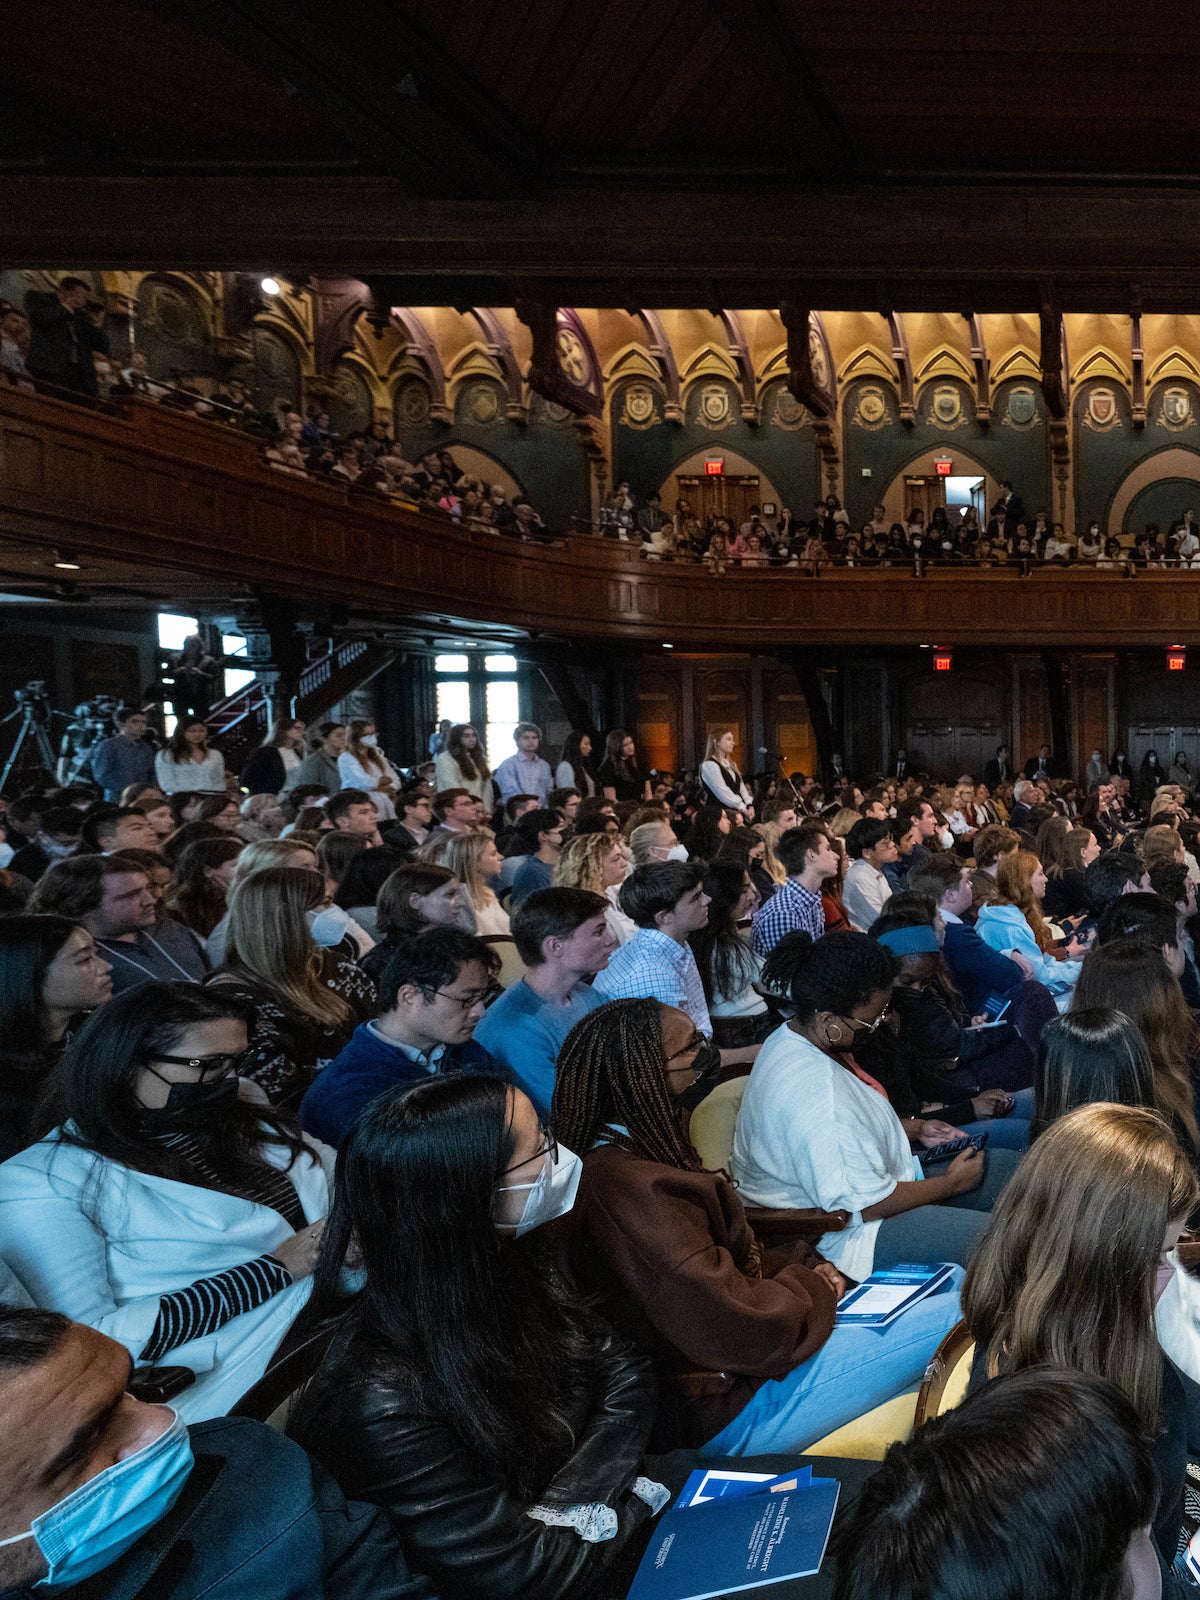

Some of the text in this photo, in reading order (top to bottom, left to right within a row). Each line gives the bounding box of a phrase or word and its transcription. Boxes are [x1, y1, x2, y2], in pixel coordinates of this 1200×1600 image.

[937, 658, 950, 670] EXIT
[1170, 658, 1183, 670] EXIT
[774, 1496, 790, 1530] MADELEINE
[760, 1538, 775, 1572] ALBRIGHT
